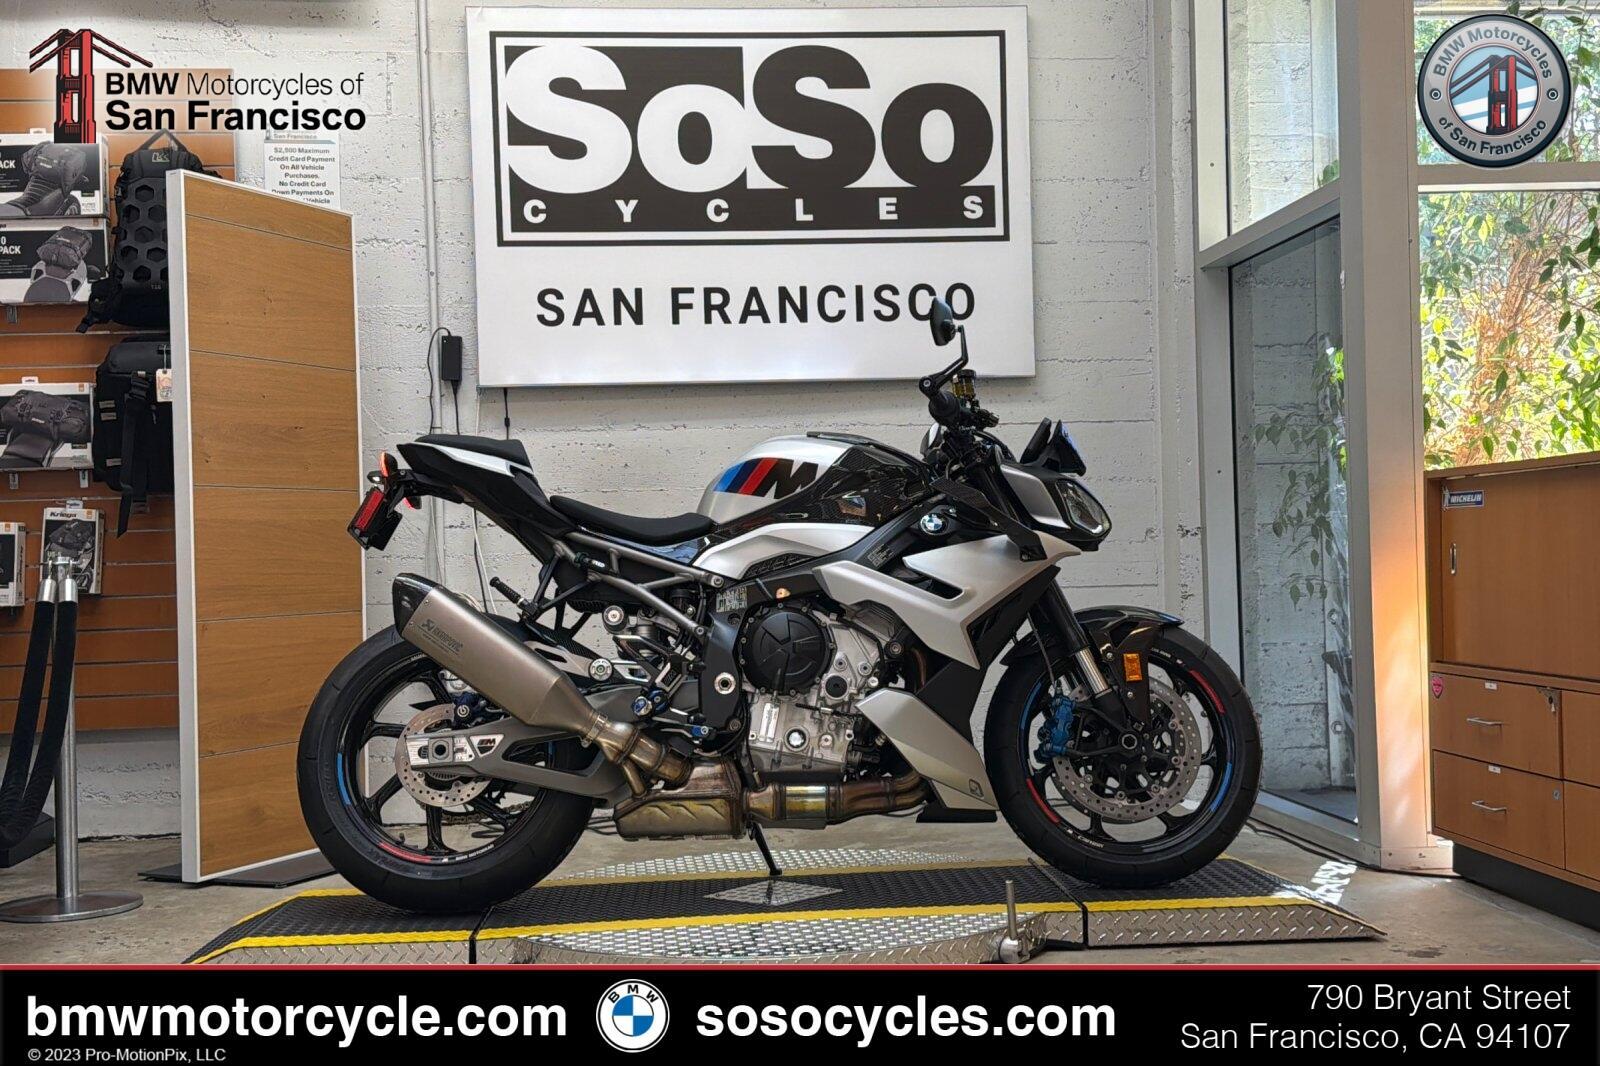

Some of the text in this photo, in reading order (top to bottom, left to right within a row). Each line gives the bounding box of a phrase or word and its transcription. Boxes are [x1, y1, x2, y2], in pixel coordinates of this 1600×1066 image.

[306, 155, 335, 163] Payment
[291, 189, 323, 197] Payments
[523, 195, 983, 224] CYCLES
[536, 282, 975, 327] SAN FRANCISCO
[1450, 493, 1483, 503] MICHELIN
